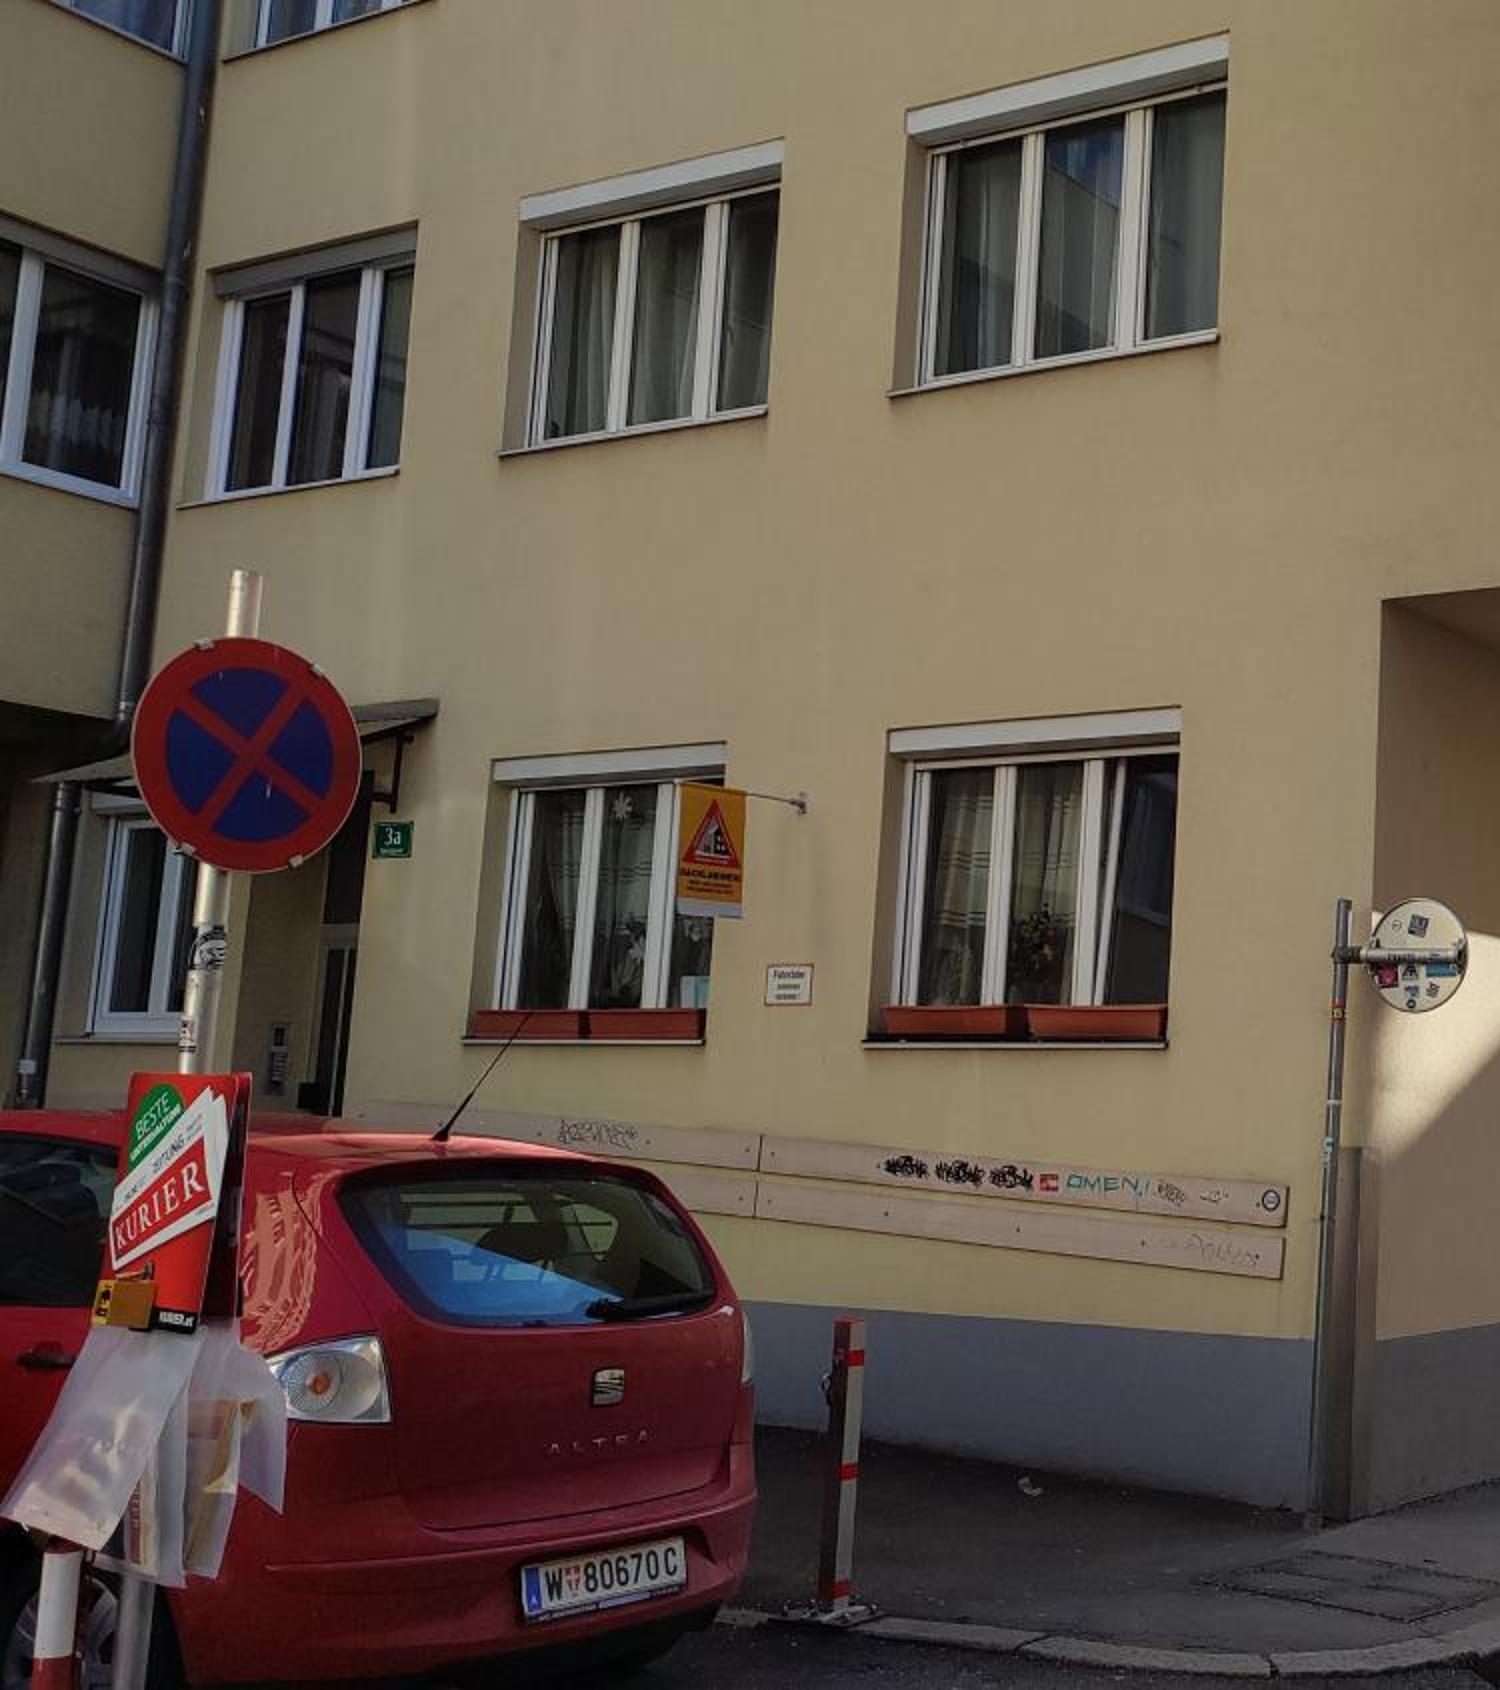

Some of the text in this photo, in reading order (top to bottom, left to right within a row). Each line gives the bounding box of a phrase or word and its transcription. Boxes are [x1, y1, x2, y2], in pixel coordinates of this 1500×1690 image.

[383, 827, 401, 847] 3a
[135, 1091, 169, 1141] BESTE
[114, 1161, 205, 1251] KURIER
